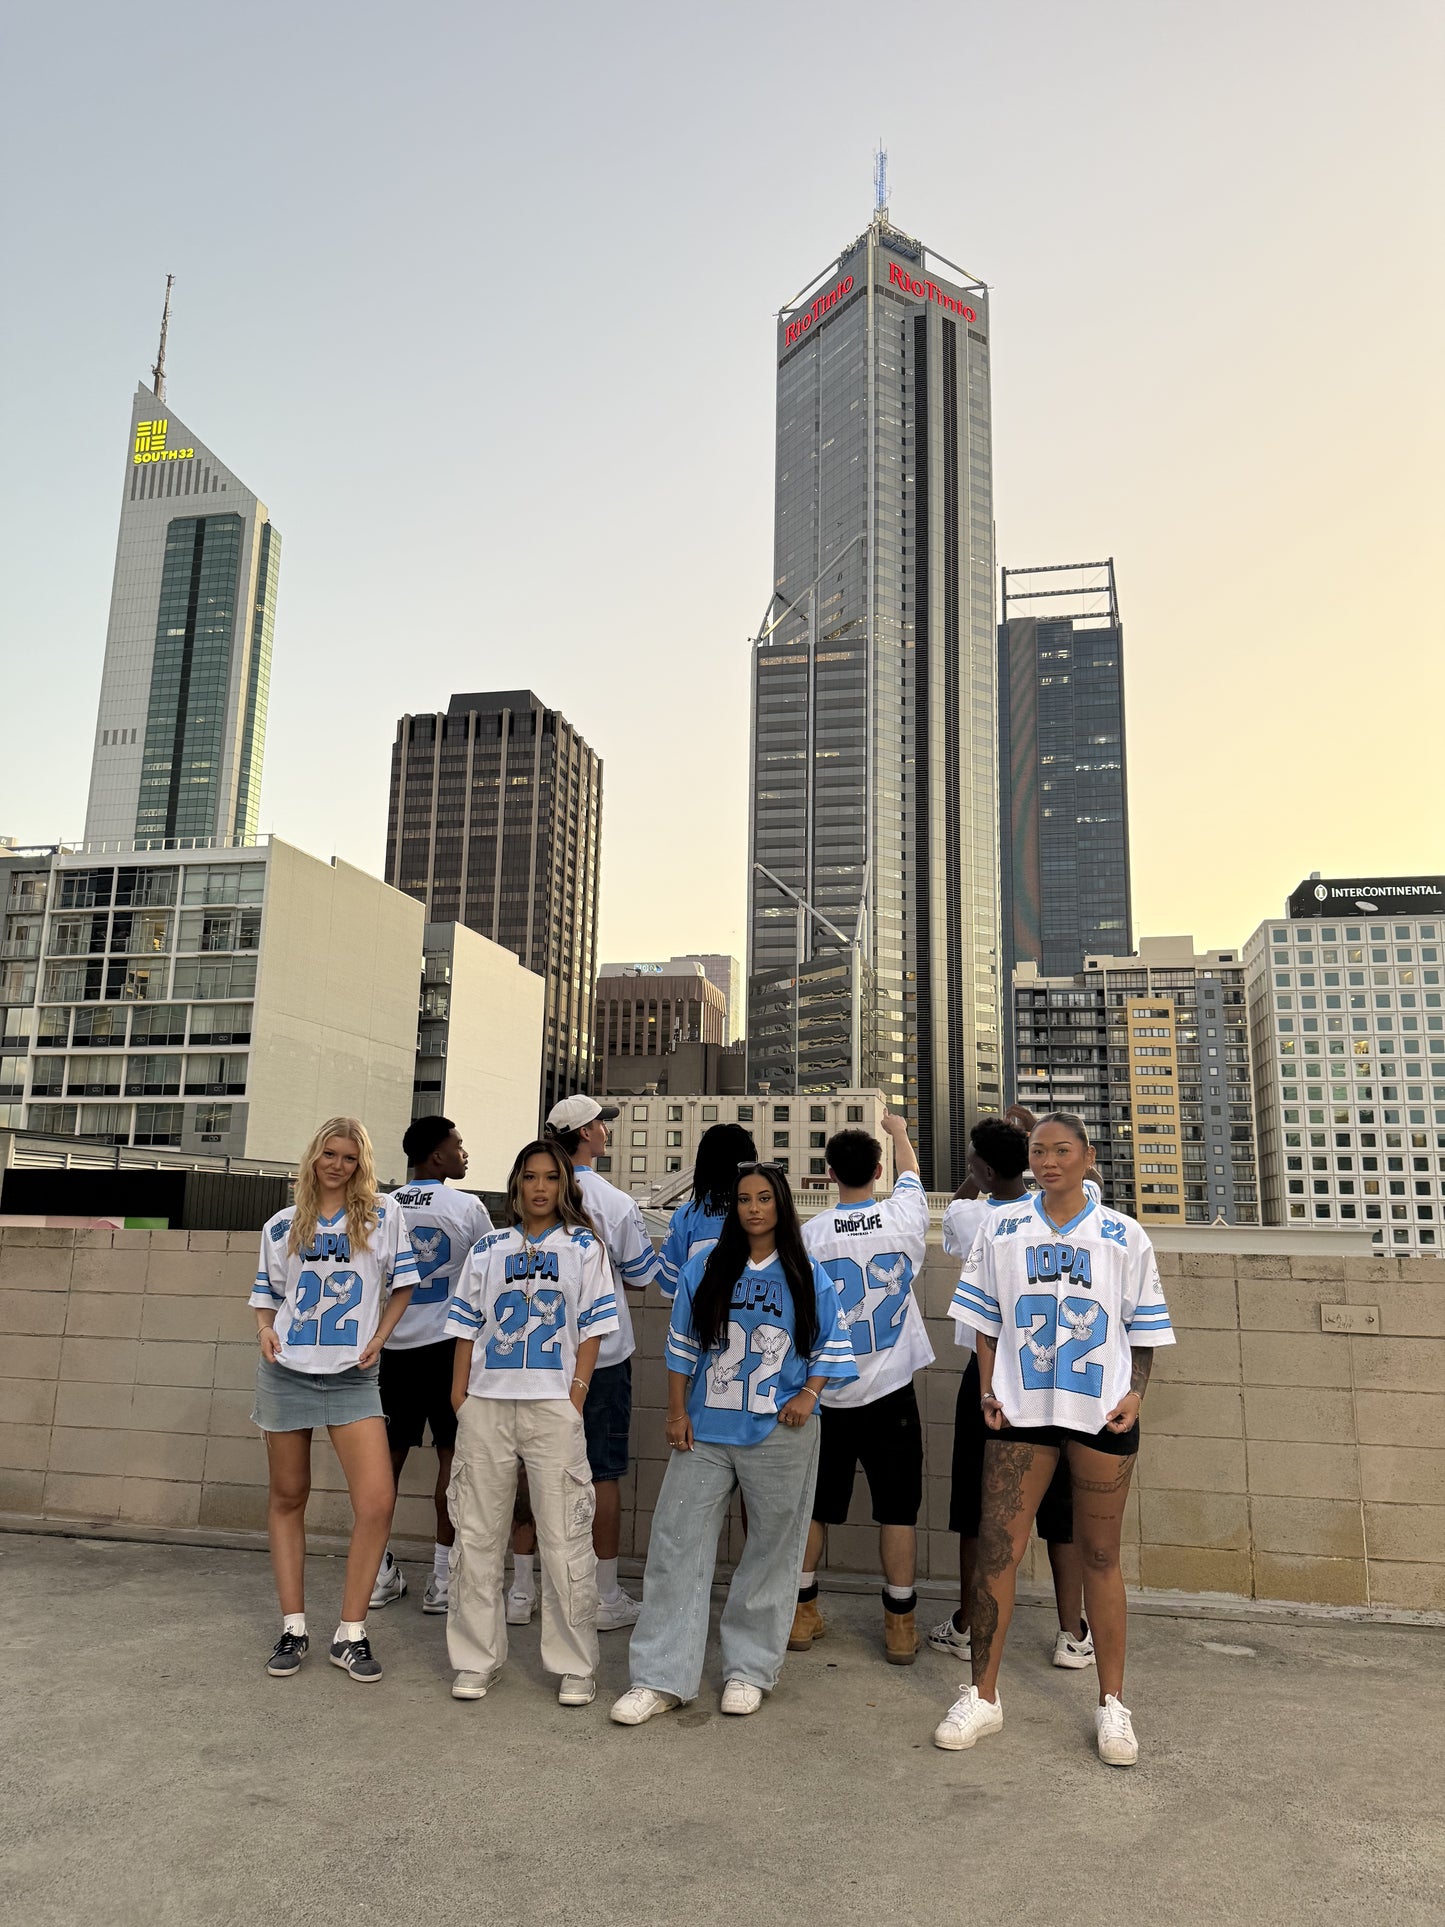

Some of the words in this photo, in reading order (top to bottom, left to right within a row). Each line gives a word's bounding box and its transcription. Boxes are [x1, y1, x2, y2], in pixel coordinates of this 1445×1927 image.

[133, 448, 195, 464] SOUTH32
[414, 1191, 434, 1206] LIFE
[834, 1218, 860, 1233] CHOP
[860, 1213, 883, 1231] LIFE
[1101, 1219, 1128, 1247] 22
[300, 1233, 351, 1264] OPA
[505, 1251, 560, 1284] IOPA
[1025, 1242, 1092, 1290] IOPA
[286, 1271, 364, 1346] 22
[731, 1276, 783, 1317] OPA
[819, 1251, 915, 1356] 22
[485, 1289, 567, 1370] 22
[1015, 1293, 1109, 1399] 22
[704, 1320, 792, 1415] 22
